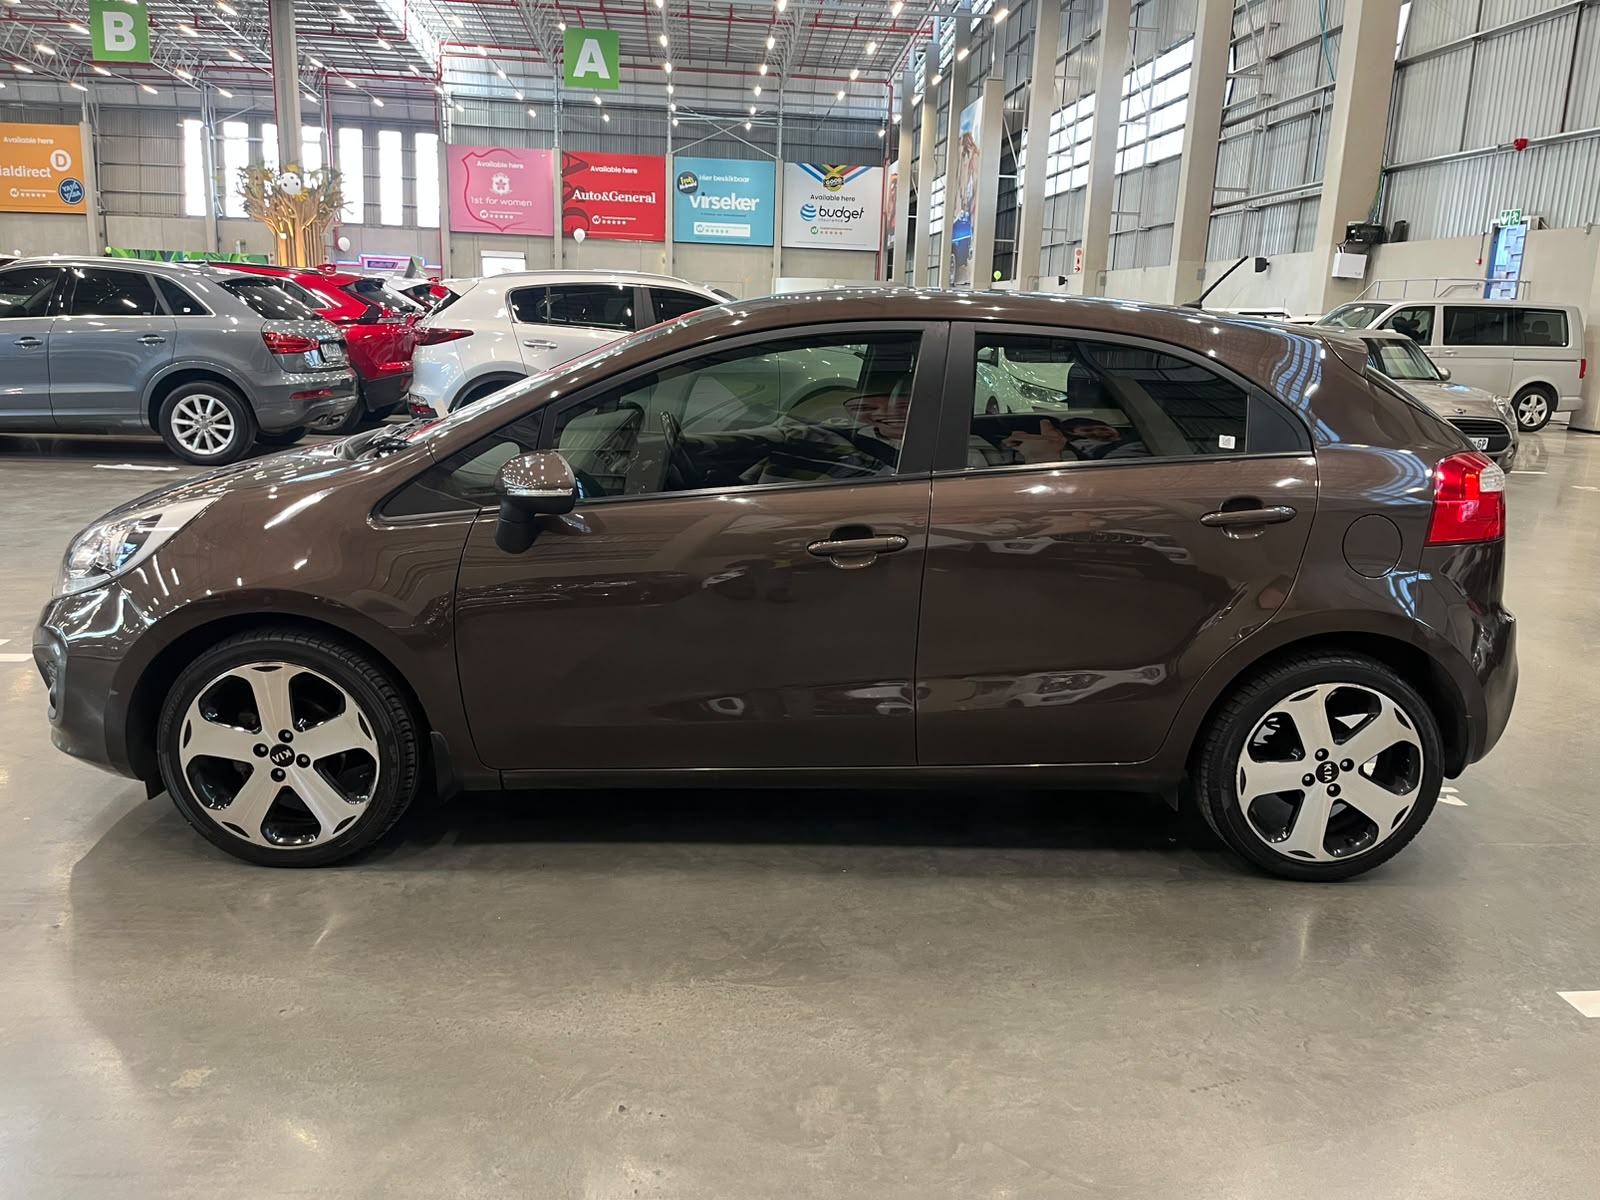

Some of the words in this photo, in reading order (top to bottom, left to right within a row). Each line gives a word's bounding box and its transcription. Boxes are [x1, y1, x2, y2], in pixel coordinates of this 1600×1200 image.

[102, 11, 137, 52] B
[573, 38, 611, 79] A
[3, 136, 37, 144] Available
[37, 137, 54, 145] here
[477, 160, 508, 168] Available
[590, 165, 621, 173] Available
[622, 166, 638, 174] here
[713, 174, 750, 183] beskikbaar
[485, 197, 498, 205] for
[572, 189, 656, 204] Auto&General
[689, 191, 760, 211] virseker
[810, 193, 840, 201] Available
[818, 204, 865, 223] budget
[271, 748, 292, 763] KIA
[1323, 763, 1332, 782] KIA
